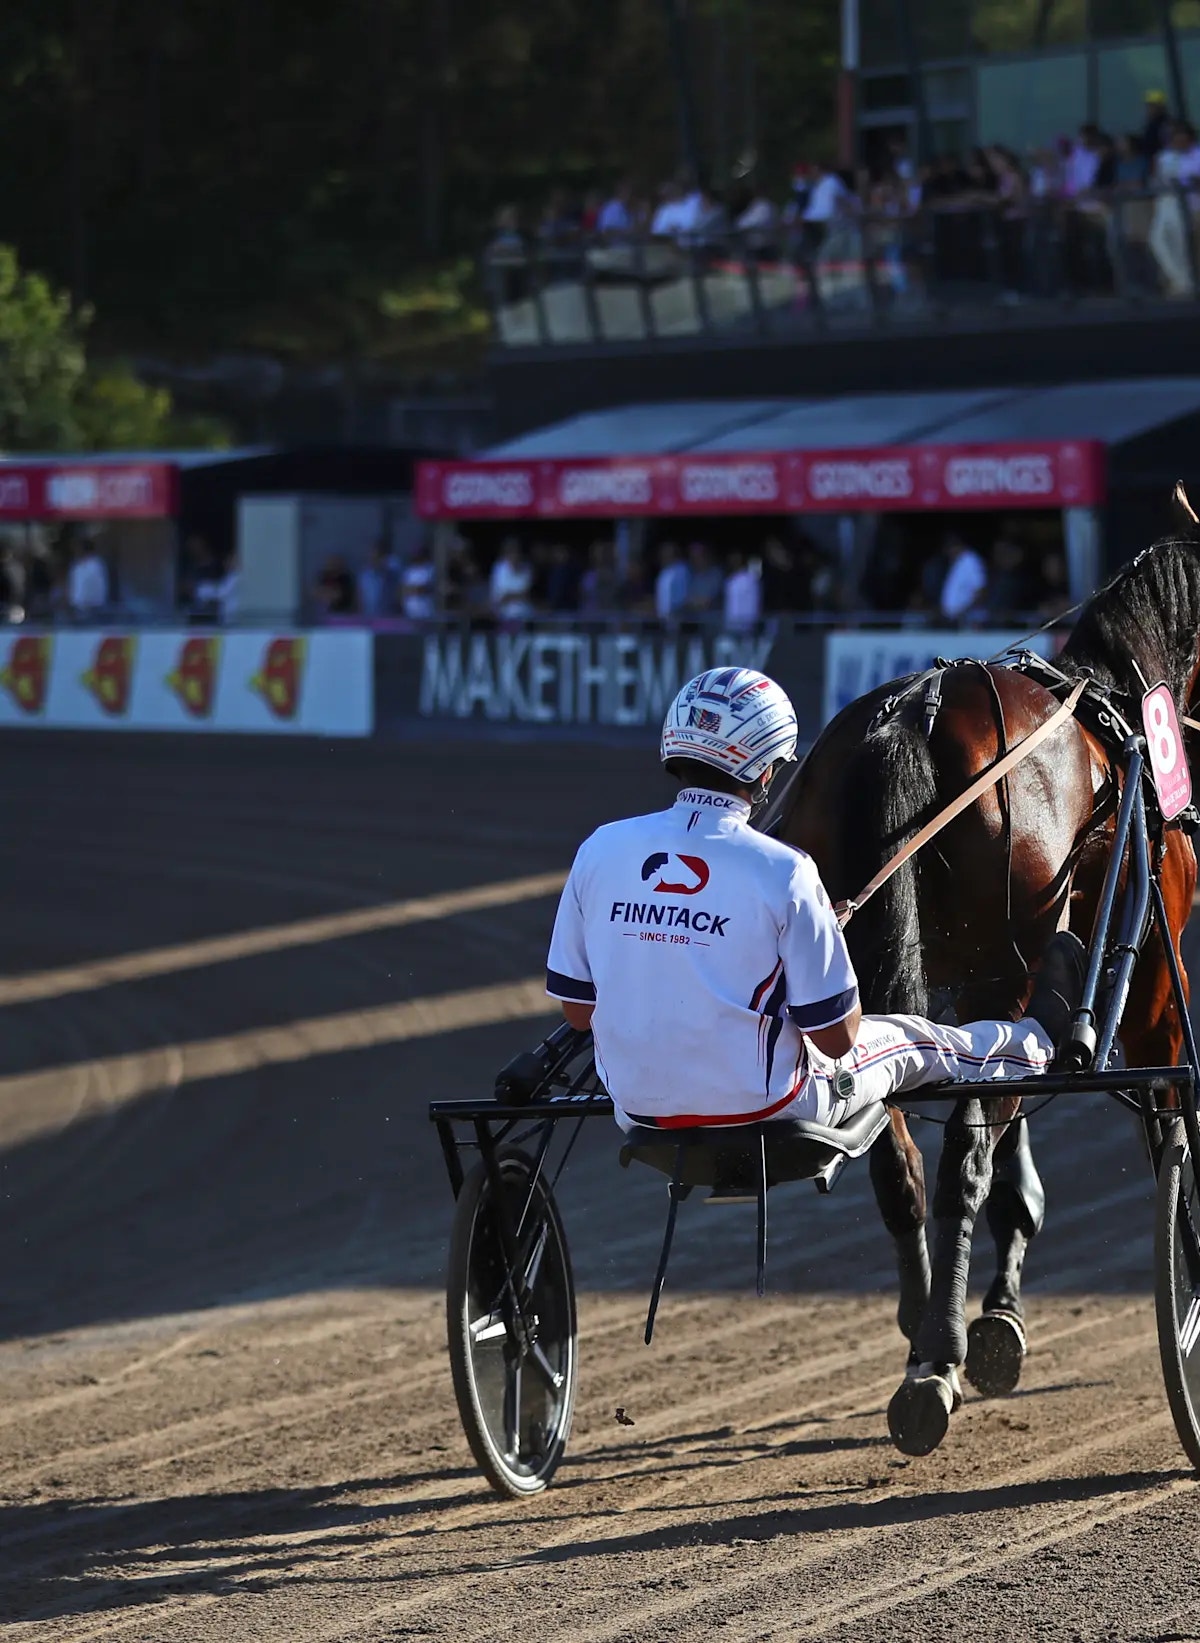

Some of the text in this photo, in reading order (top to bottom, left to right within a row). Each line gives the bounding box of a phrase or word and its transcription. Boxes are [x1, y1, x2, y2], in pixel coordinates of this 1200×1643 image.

[1148, 693, 1177, 774] 8
[610, 902, 731, 937] FINNTACK
[639, 932, 690, 945] SINCE 1982
